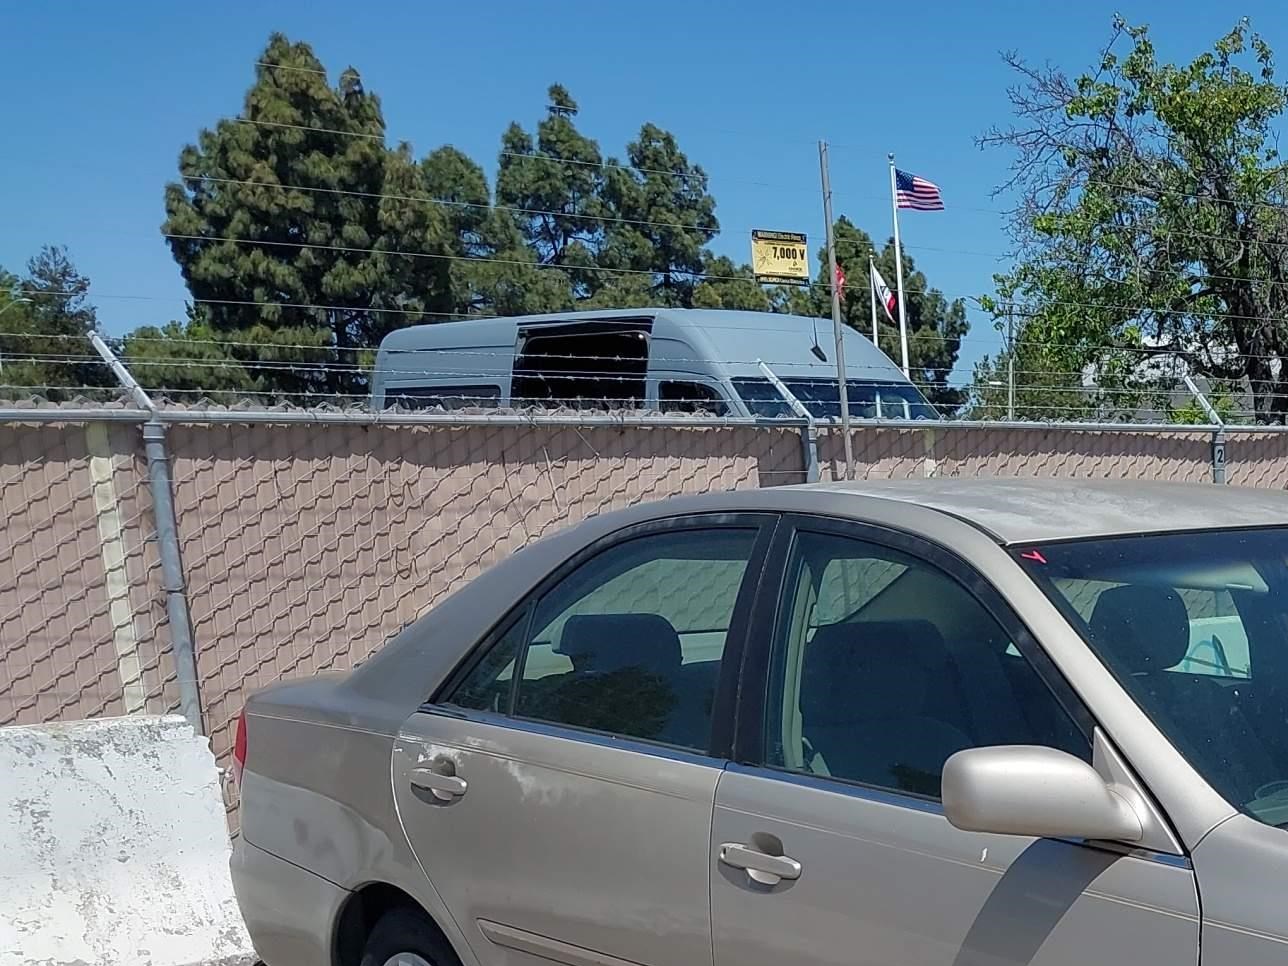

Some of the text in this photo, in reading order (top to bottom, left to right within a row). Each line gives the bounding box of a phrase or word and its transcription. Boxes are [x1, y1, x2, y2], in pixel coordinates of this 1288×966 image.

[772, 246, 805, 261] 7,000 V
[1217, 449, 1223, 463] 2
